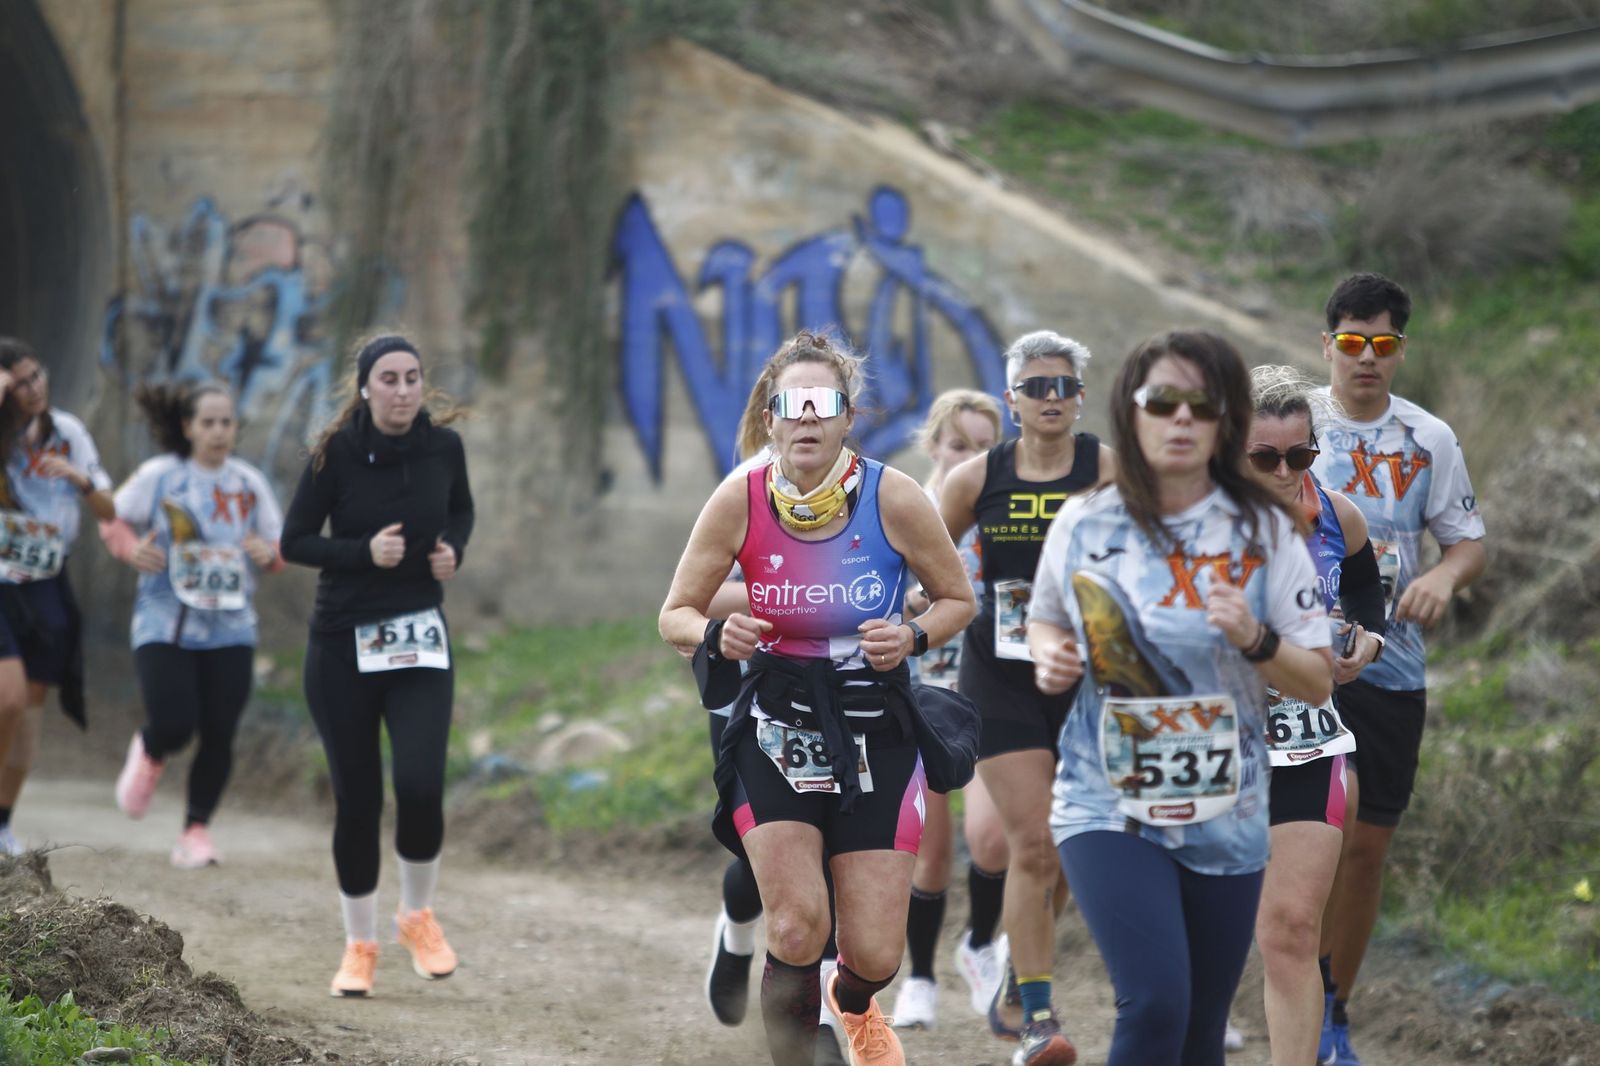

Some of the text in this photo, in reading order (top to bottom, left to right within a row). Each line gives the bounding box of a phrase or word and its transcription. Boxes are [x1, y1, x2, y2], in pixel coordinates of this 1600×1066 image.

[1343, 440, 1430, 502] XV
[984, 525, 1039, 533] ANDRÉS
[841, 555, 870, 565] GSPORT
[1157, 542, 1264, 610] XV
[765, 606, 816, 616] deportivo
[381, 622, 442, 647] 614
[1150, 702, 1225, 737] XV
[1268, 709, 1337, 743] 610
[1135, 749, 1233, 788] 537
